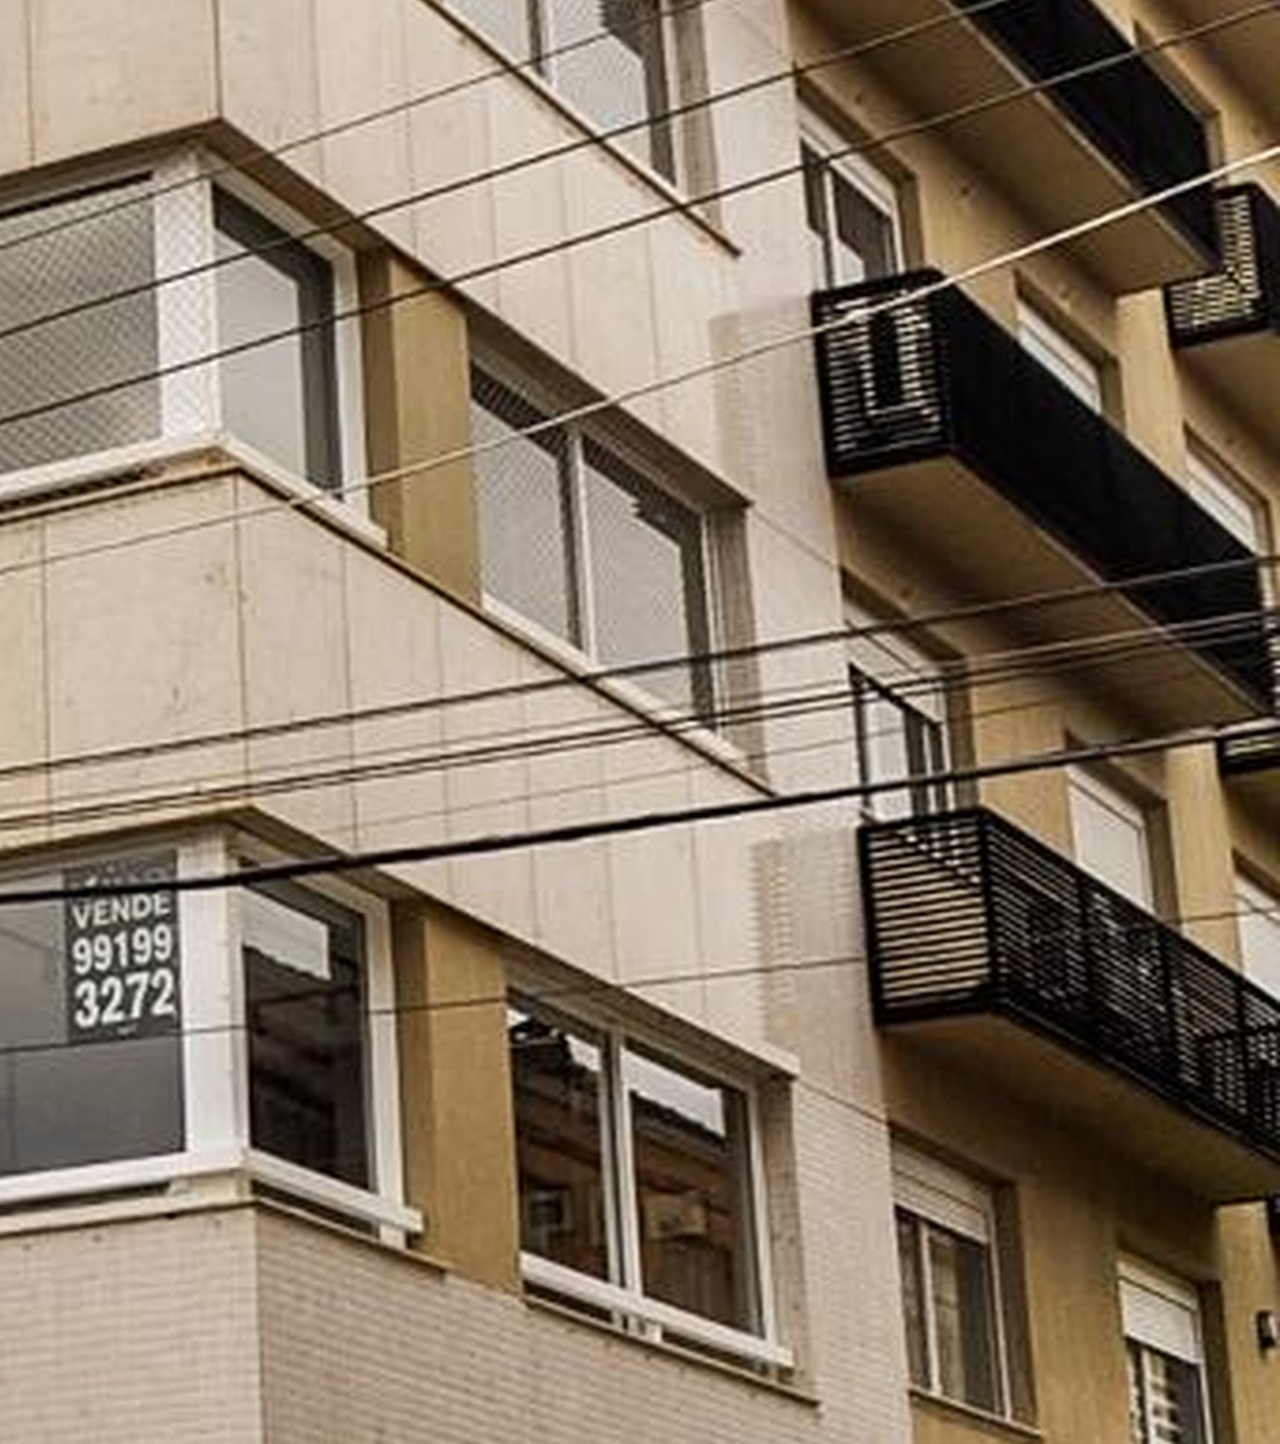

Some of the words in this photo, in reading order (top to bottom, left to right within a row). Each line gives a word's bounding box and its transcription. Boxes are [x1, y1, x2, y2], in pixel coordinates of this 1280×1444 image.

[71, 893, 172, 929] VENDE
[71, 923, 173, 975] 99199
[74, 967, 177, 1028] 3272
